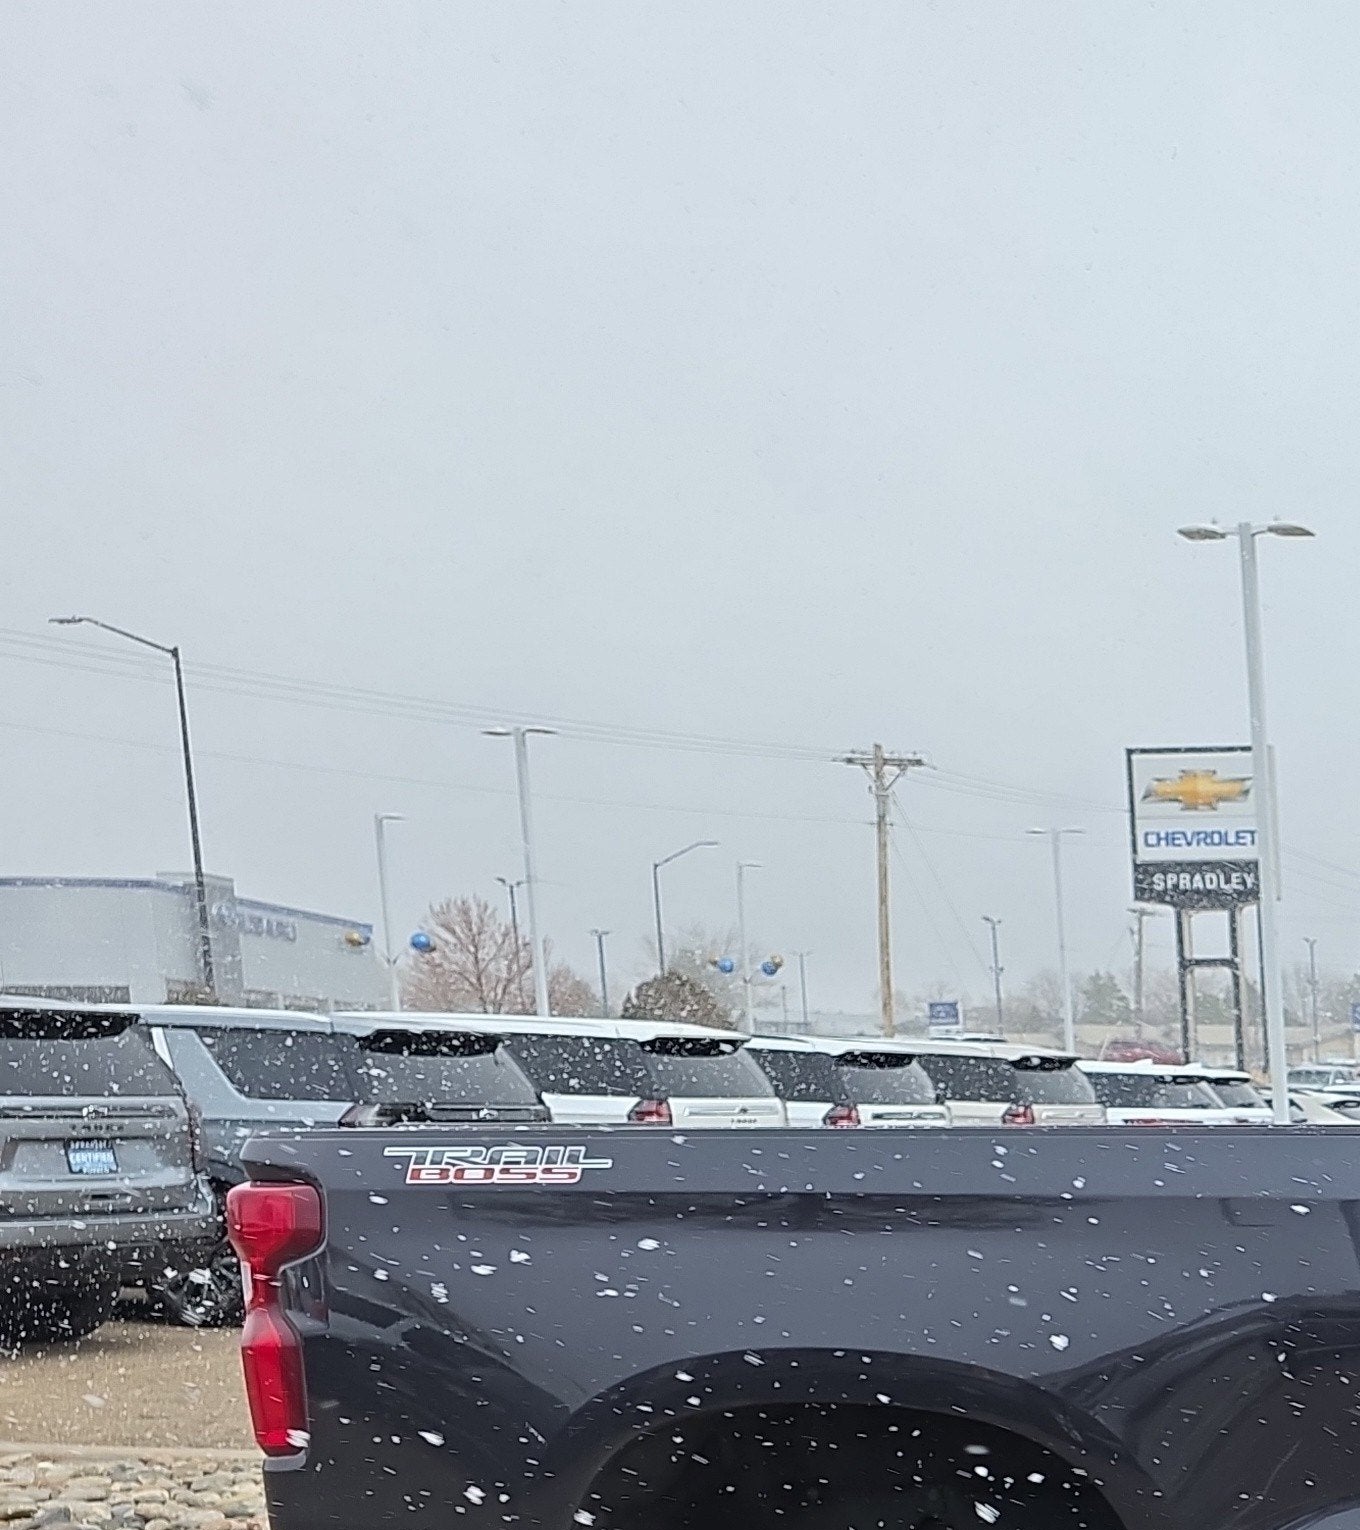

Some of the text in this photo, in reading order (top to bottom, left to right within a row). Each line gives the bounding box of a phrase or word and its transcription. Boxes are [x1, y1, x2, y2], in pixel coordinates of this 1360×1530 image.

[1144, 830, 1257, 848] CHEVROLET
[1152, 871, 1257, 891] SPRADLEY
[383, 1146, 613, 1168] TRAIL
[405, 1164, 583, 1185] BOSS
